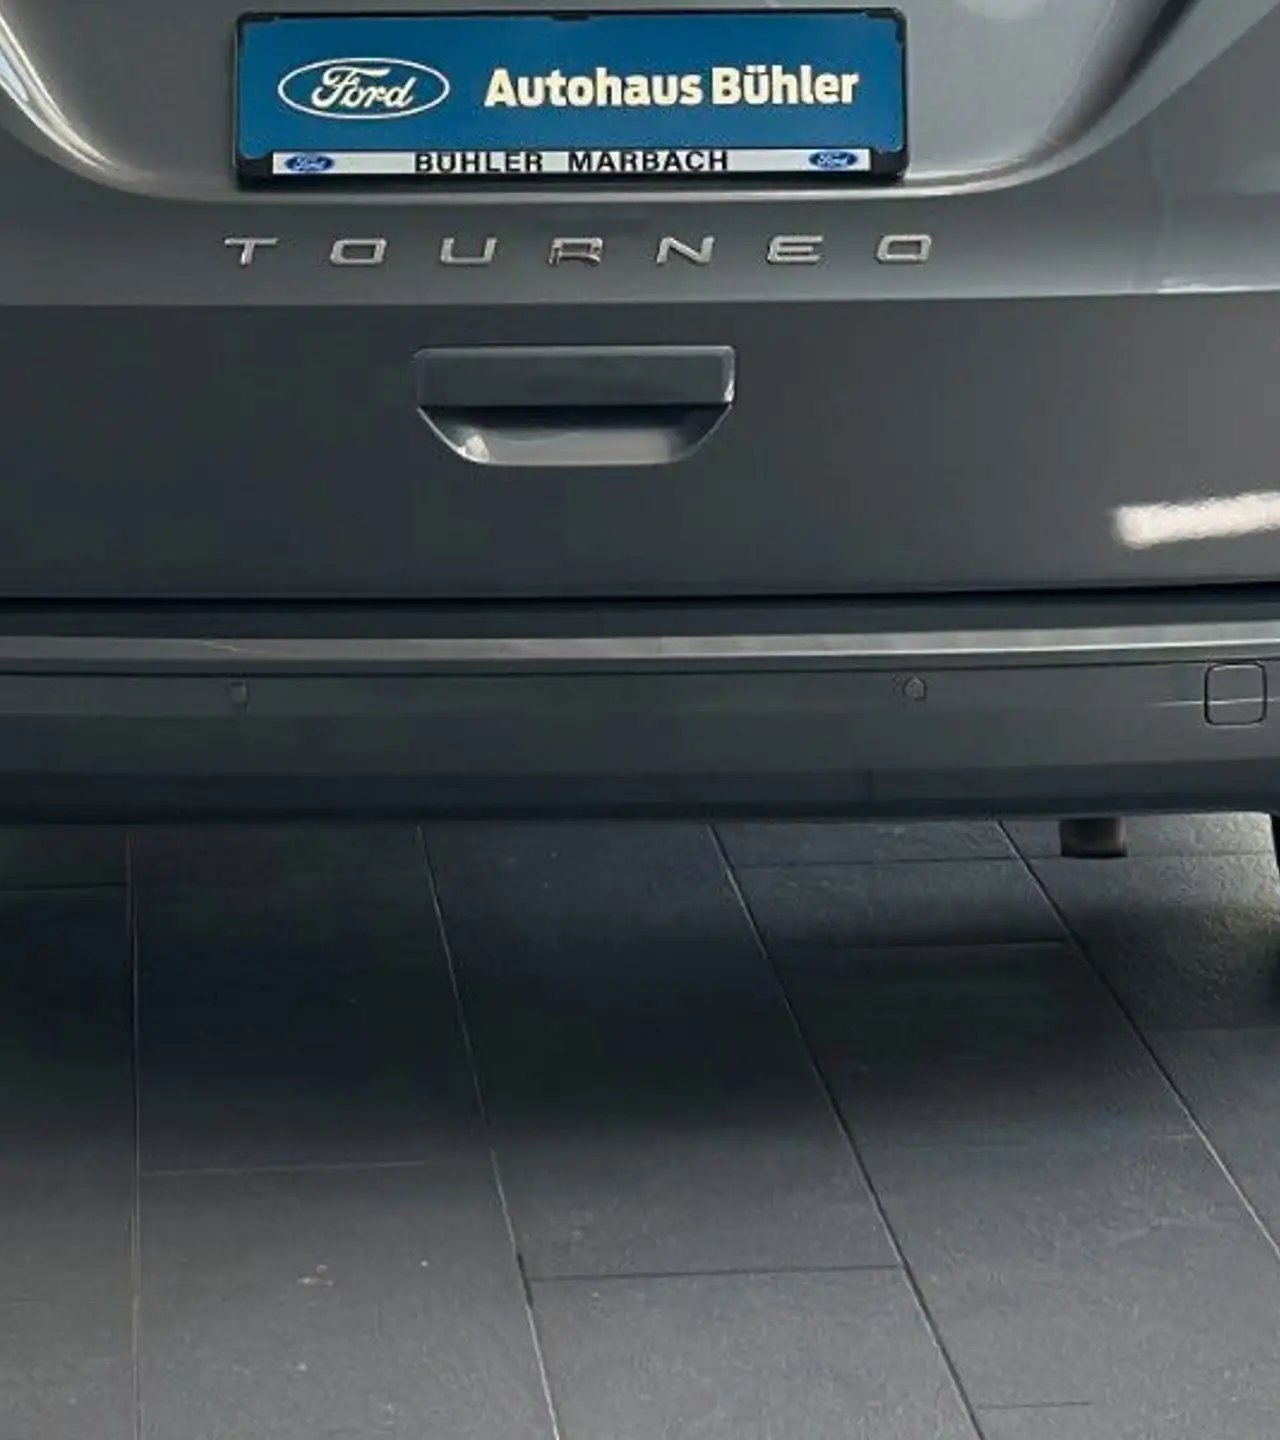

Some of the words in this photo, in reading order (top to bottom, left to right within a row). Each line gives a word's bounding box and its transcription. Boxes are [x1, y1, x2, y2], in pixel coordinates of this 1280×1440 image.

[311, 65, 417, 108] Ford
[483, 66, 704, 107] Autohaus
[711, 64, 860, 105] Bühler
[570, 150, 729, 172] MARBACH
[224, 234, 933, 266] TOURNEO
